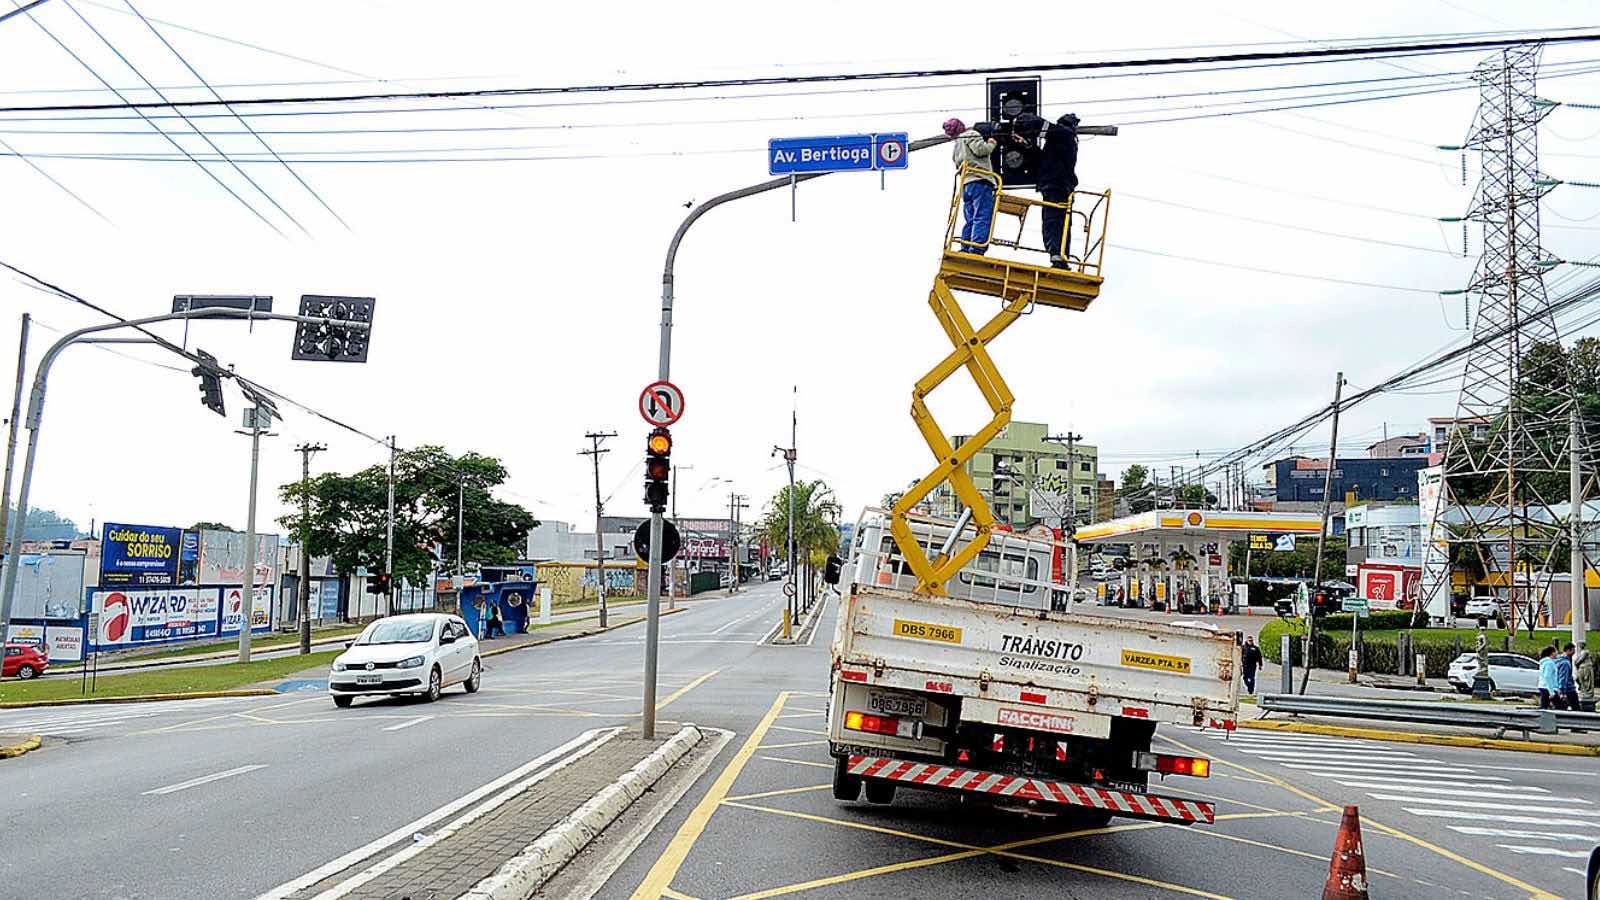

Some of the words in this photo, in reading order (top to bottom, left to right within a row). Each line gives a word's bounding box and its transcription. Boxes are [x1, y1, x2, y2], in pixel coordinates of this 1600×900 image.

[773, 149, 797, 163] Av.
[801, 146, 869, 164] Bertioga
[108, 529, 138, 542] Cuidar
[139, 531, 150, 543] do
[150, 534, 165, 544] seu
[127, 543, 172, 559] SORRISO
[130, 595, 187, 615] WIZARD
[901, 624, 926, 636] DBS
[928, 627, 955, 640] 7966
[1001, 634, 1083, 661] TRÂNSITO
[1125, 655, 1157, 666] VARZEA
[999, 709, 1074, 730] FACCHINI
